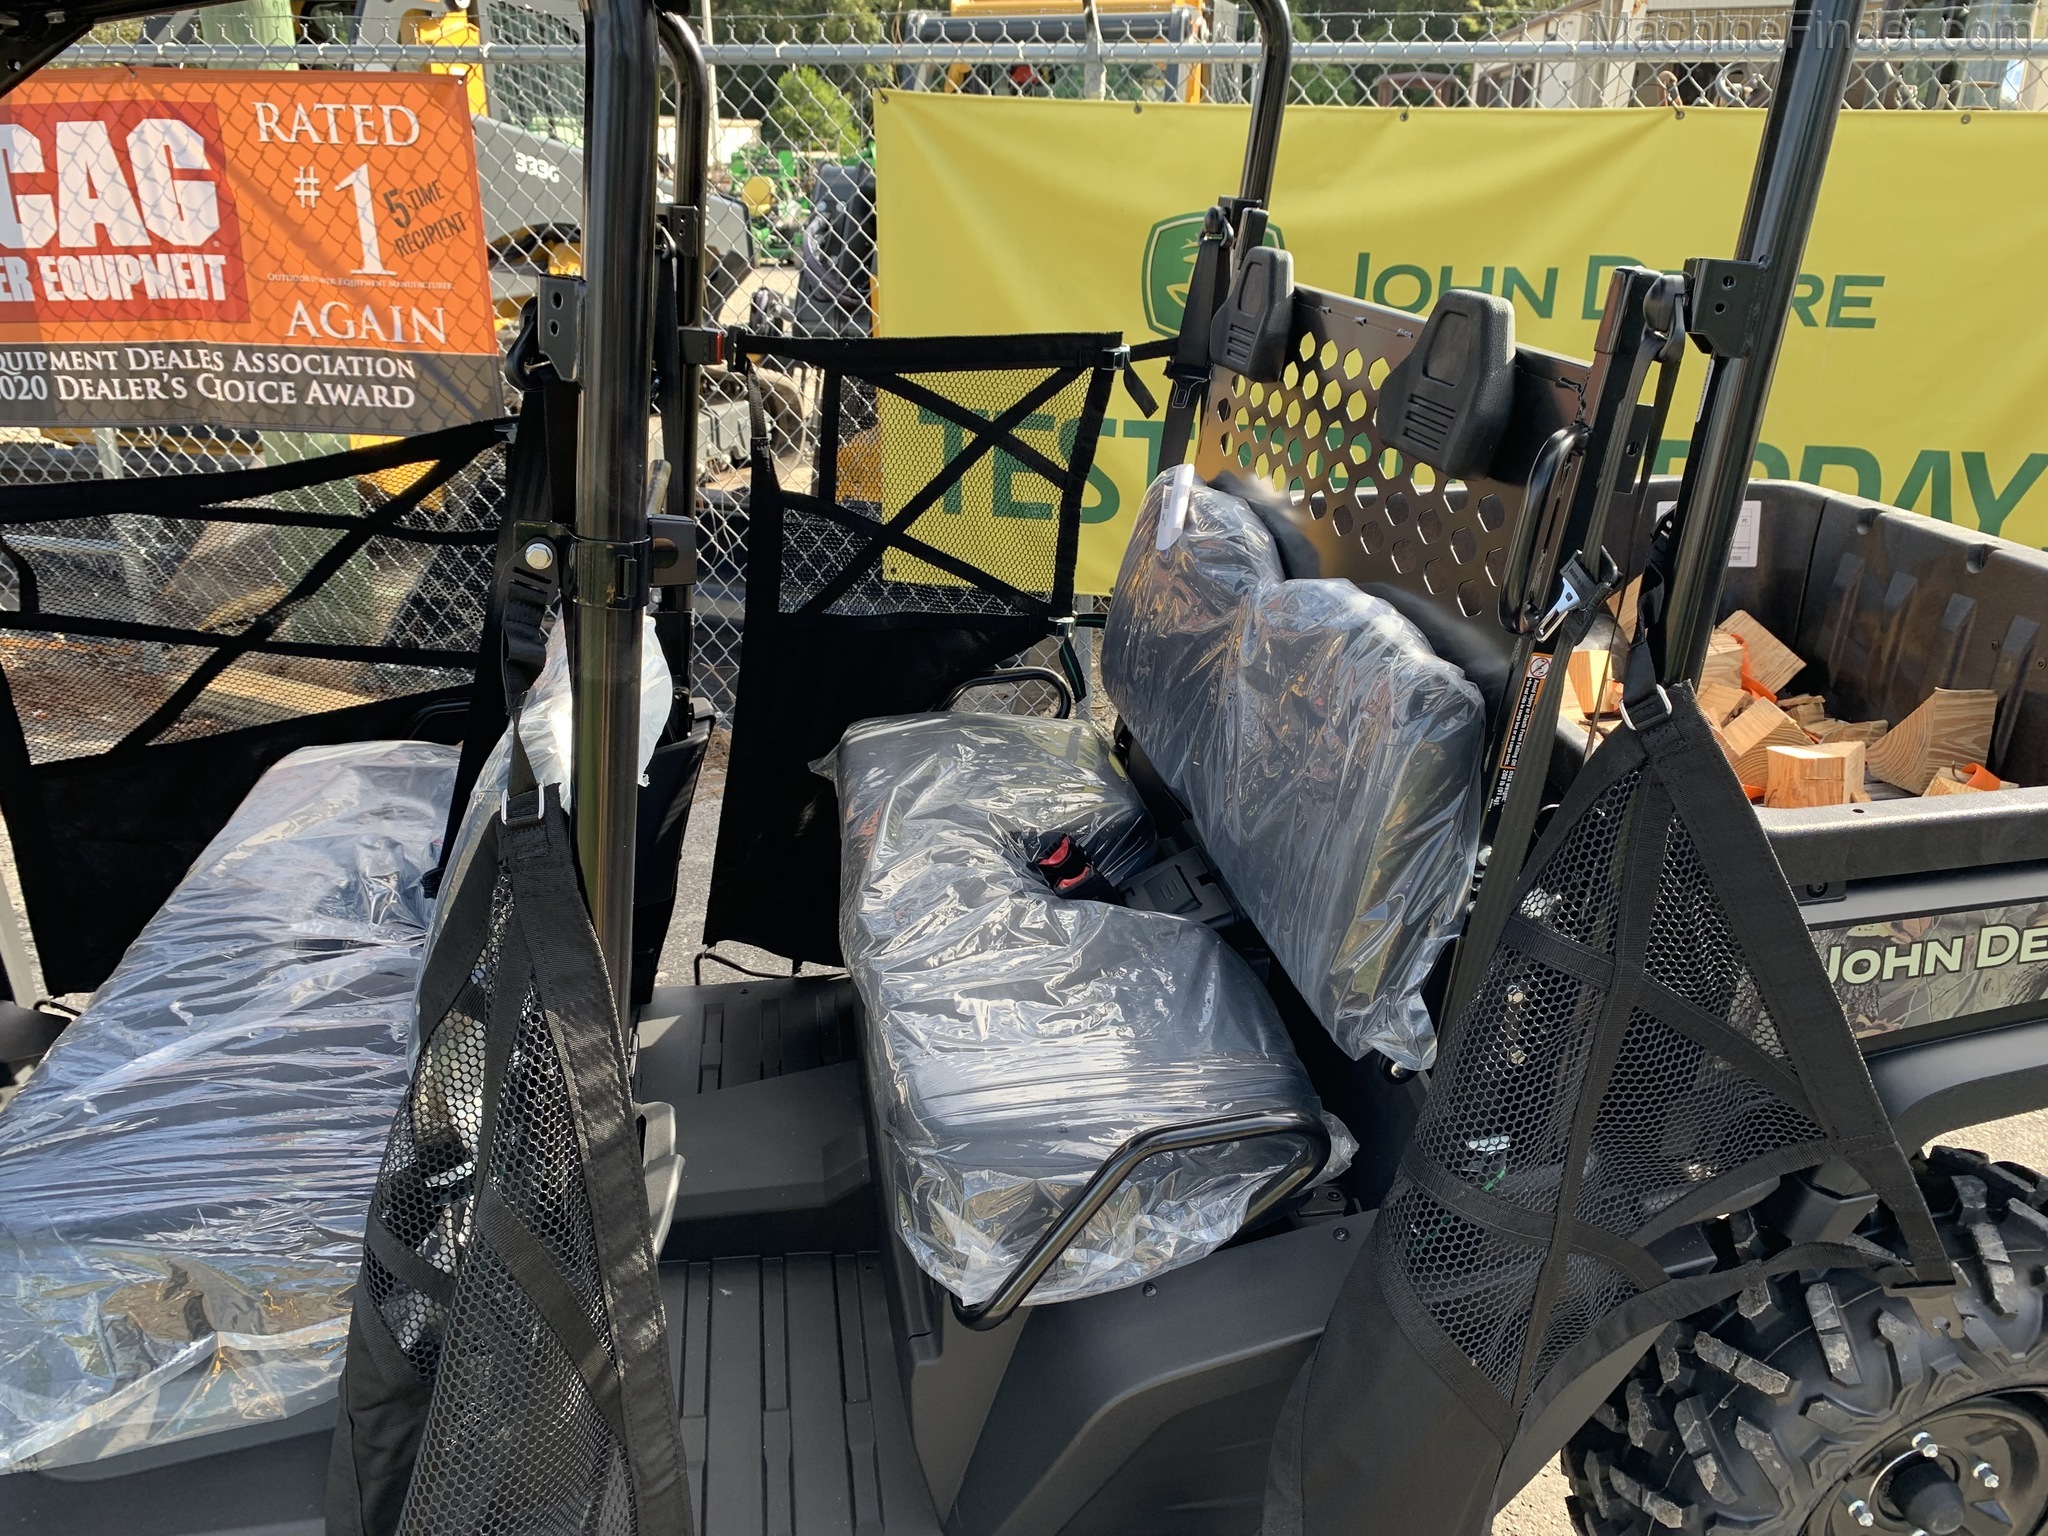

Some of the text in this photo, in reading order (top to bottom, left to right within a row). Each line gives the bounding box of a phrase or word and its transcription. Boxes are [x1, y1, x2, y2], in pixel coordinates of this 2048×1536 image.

[252, 102, 421, 147] RATED
[515, 152, 560, 184] 333G
[394, 211, 467, 258] RECIPIENT
[287, 300, 447, 344] AGAIN
[232, 352, 416, 379] ASSOCIATION
[54, 372, 188, 401] DEALER'S
[304, 379, 415, 409] AWARD
[1500, 768, 1508, 779] 200
[1828, 936, 1965, 985] JOHN
